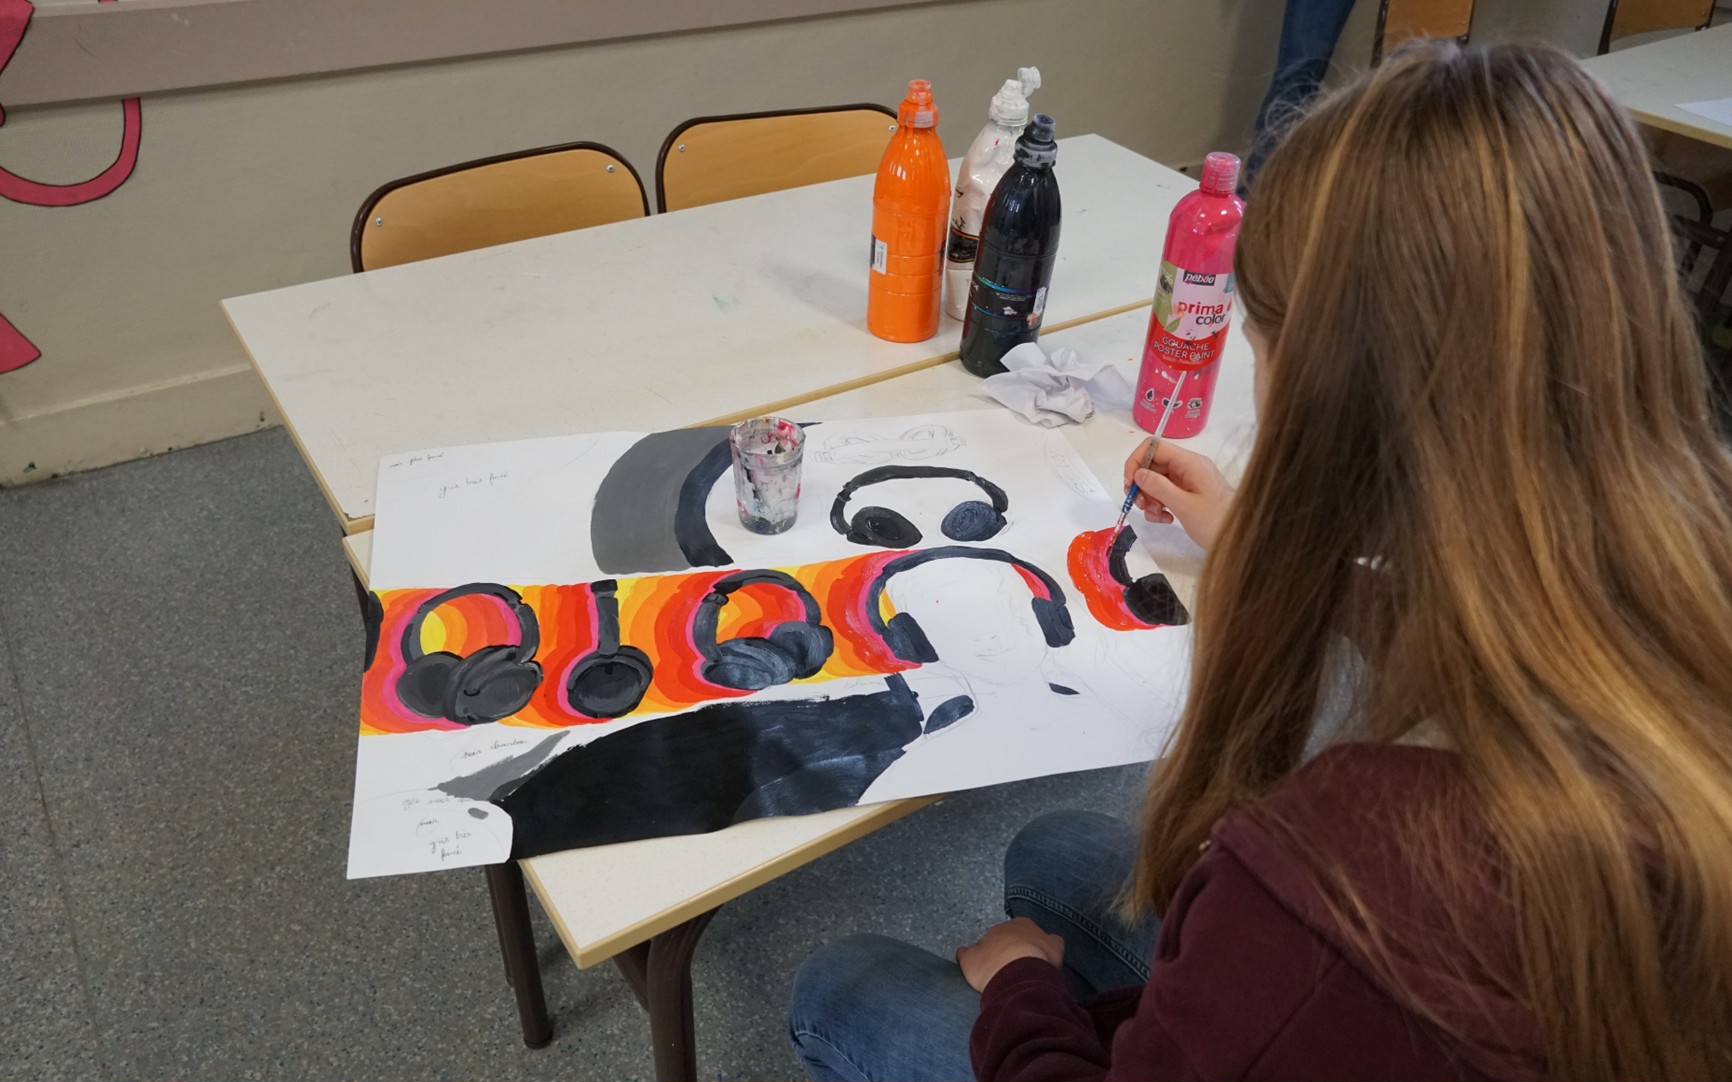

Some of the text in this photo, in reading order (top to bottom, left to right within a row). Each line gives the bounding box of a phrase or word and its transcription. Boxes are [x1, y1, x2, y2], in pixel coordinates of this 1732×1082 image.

[1177, 301, 1224, 315] prima
[1195, 314, 1225, 325] color
[1154, 341, 1188, 359] POSTER
[1162, 337, 1210, 351] GOUACHE
